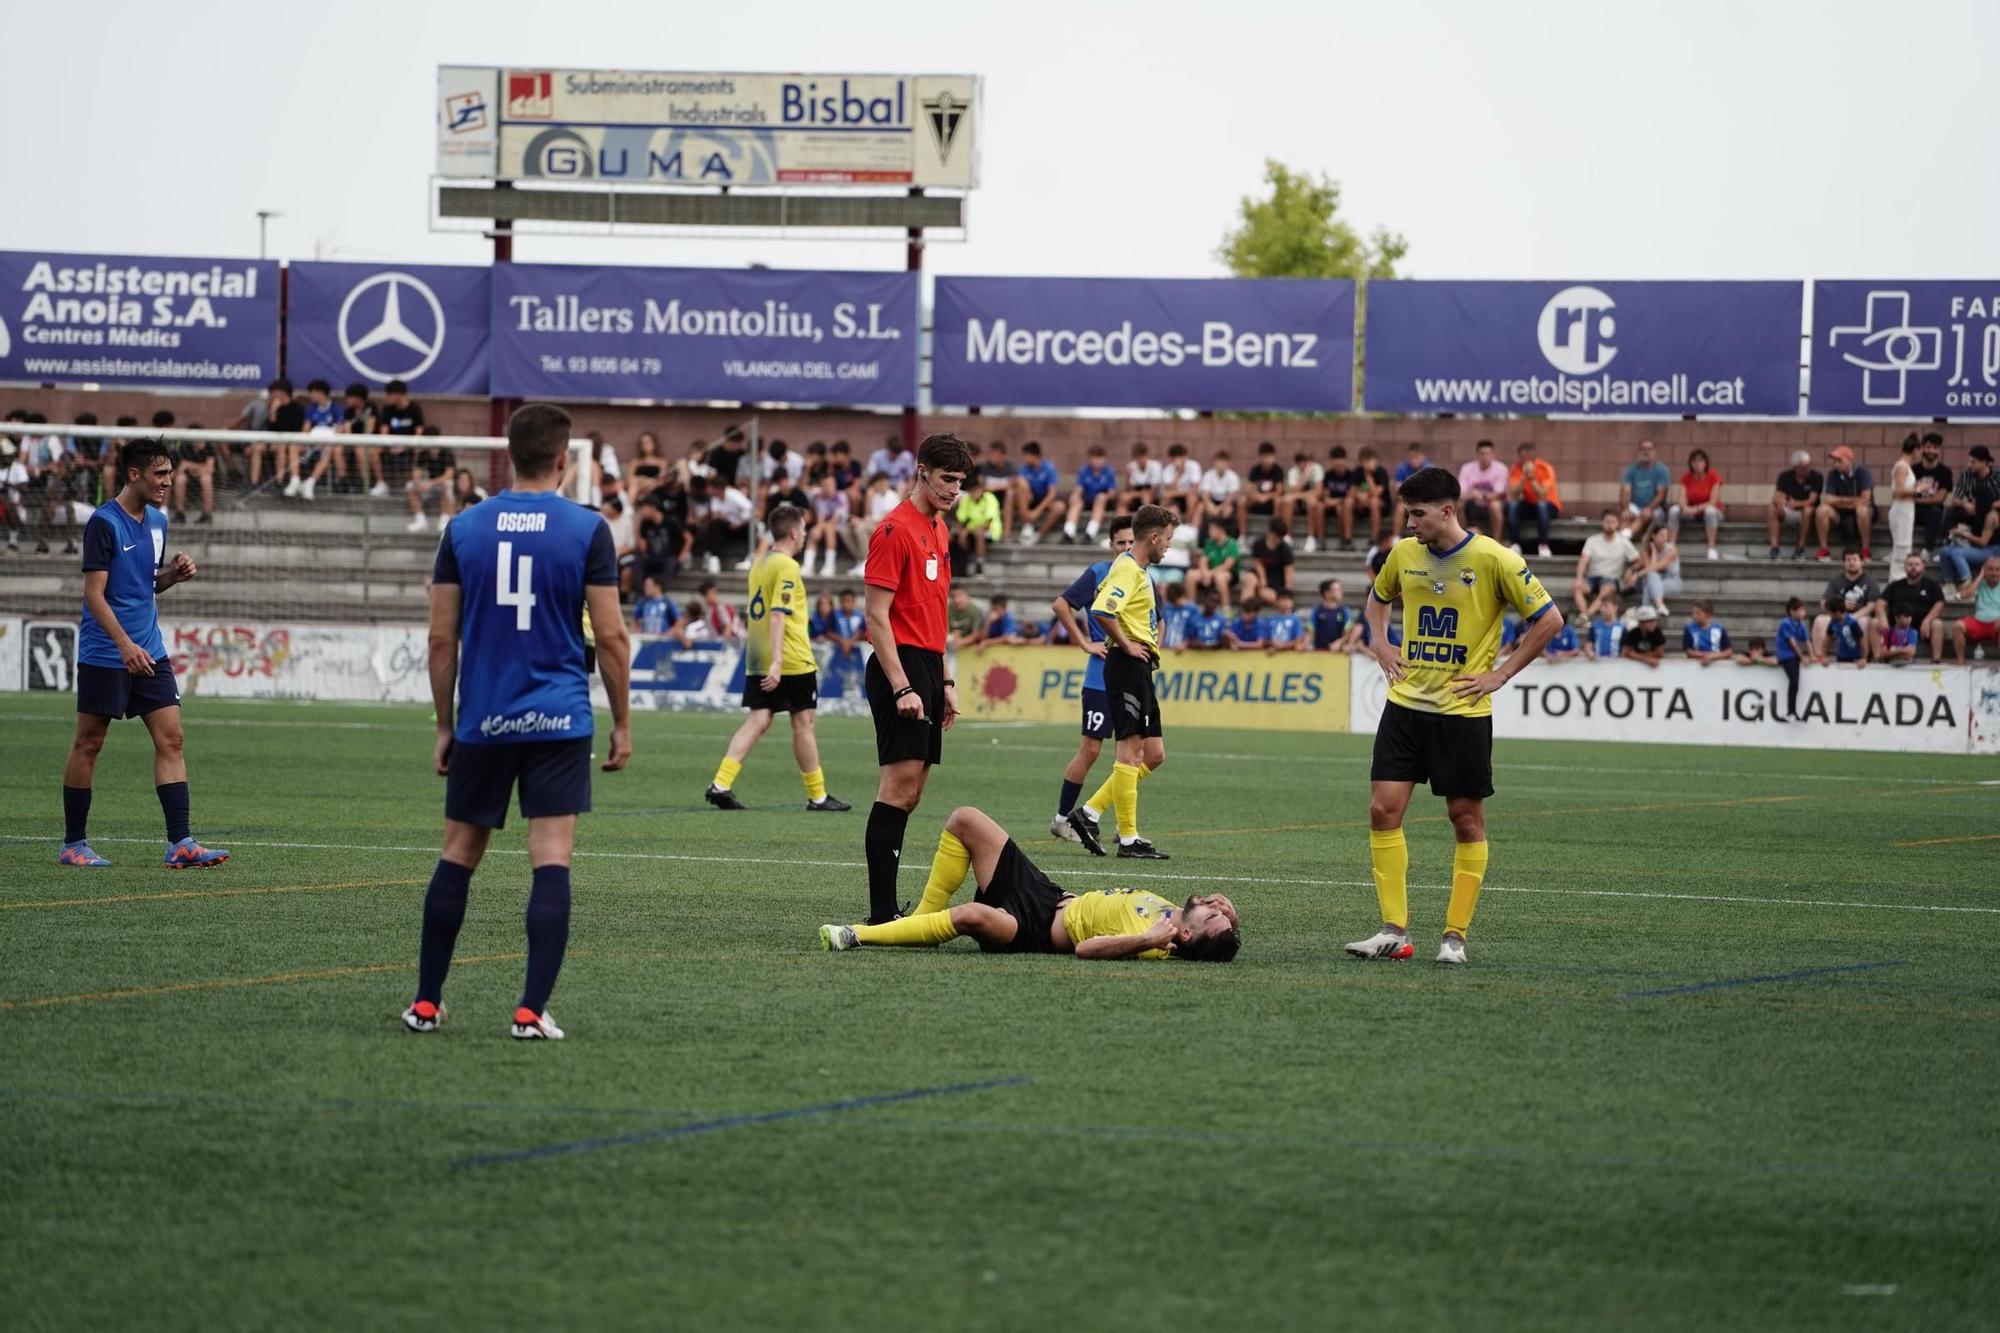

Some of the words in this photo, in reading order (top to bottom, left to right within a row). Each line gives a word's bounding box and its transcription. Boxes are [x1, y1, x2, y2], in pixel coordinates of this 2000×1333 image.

[566, 75, 735, 95] Subministraments
[668, 103, 766, 123] Industrials
[781, 80, 905, 124] Bisbal
[547, 148, 733, 179] GUMA
[24, 261, 258, 298] Assistencial
[22, 296, 145, 326] Anoia
[151, 298, 227, 328] S.A.
[510, 295, 634, 333] Tallers
[643, 298, 823, 343] Montoliu,
[832, 304, 901, 340] S.L.
[22, 325, 101, 346] Centres
[108, 327, 181, 348] Mèdics
[967, 318, 1318, 368] Mercedes-Benz
[24, 357, 261, 381] www.assistencialanoia.com
[723, 360, 800, 378] VILANOVA
[803, 362, 835, 378] DEL
[1415, 374, 1744, 412] www.retolsplanell.cat
[1945, 391, 2000, 407] ORTO
[497, 512, 546, 532] OSCAR
[496, 541, 536, 630] 4
[750, 586, 765, 621] 6
[1408, 640, 1468, 665] DICOR
[1154, 671, 1322, 702] MIRALLES
[1515, 684, 1693, 721] TOYOTA
[1086, 710, 1104, 731] 19
